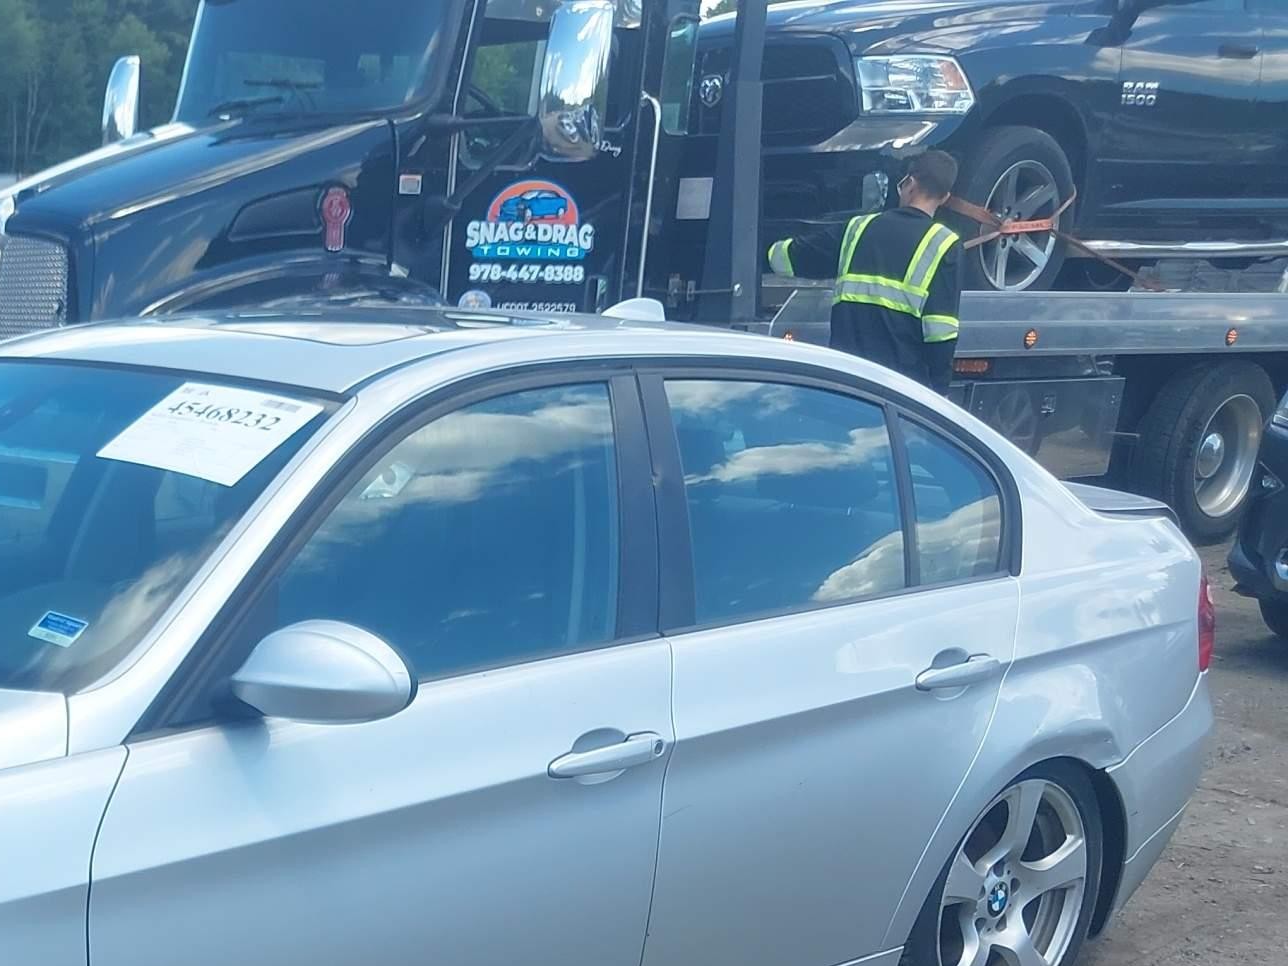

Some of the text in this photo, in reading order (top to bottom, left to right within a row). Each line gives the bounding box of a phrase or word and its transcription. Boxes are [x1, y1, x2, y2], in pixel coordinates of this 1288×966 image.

[1122, 82, 1160, 94] RAM
[1121, 94, 1157, 106] 1500
[481, 246, 579, 258] TOWING
[469, 263, 585, 283] 978-447-8388
[168, 400, 281, 431] 45468232
